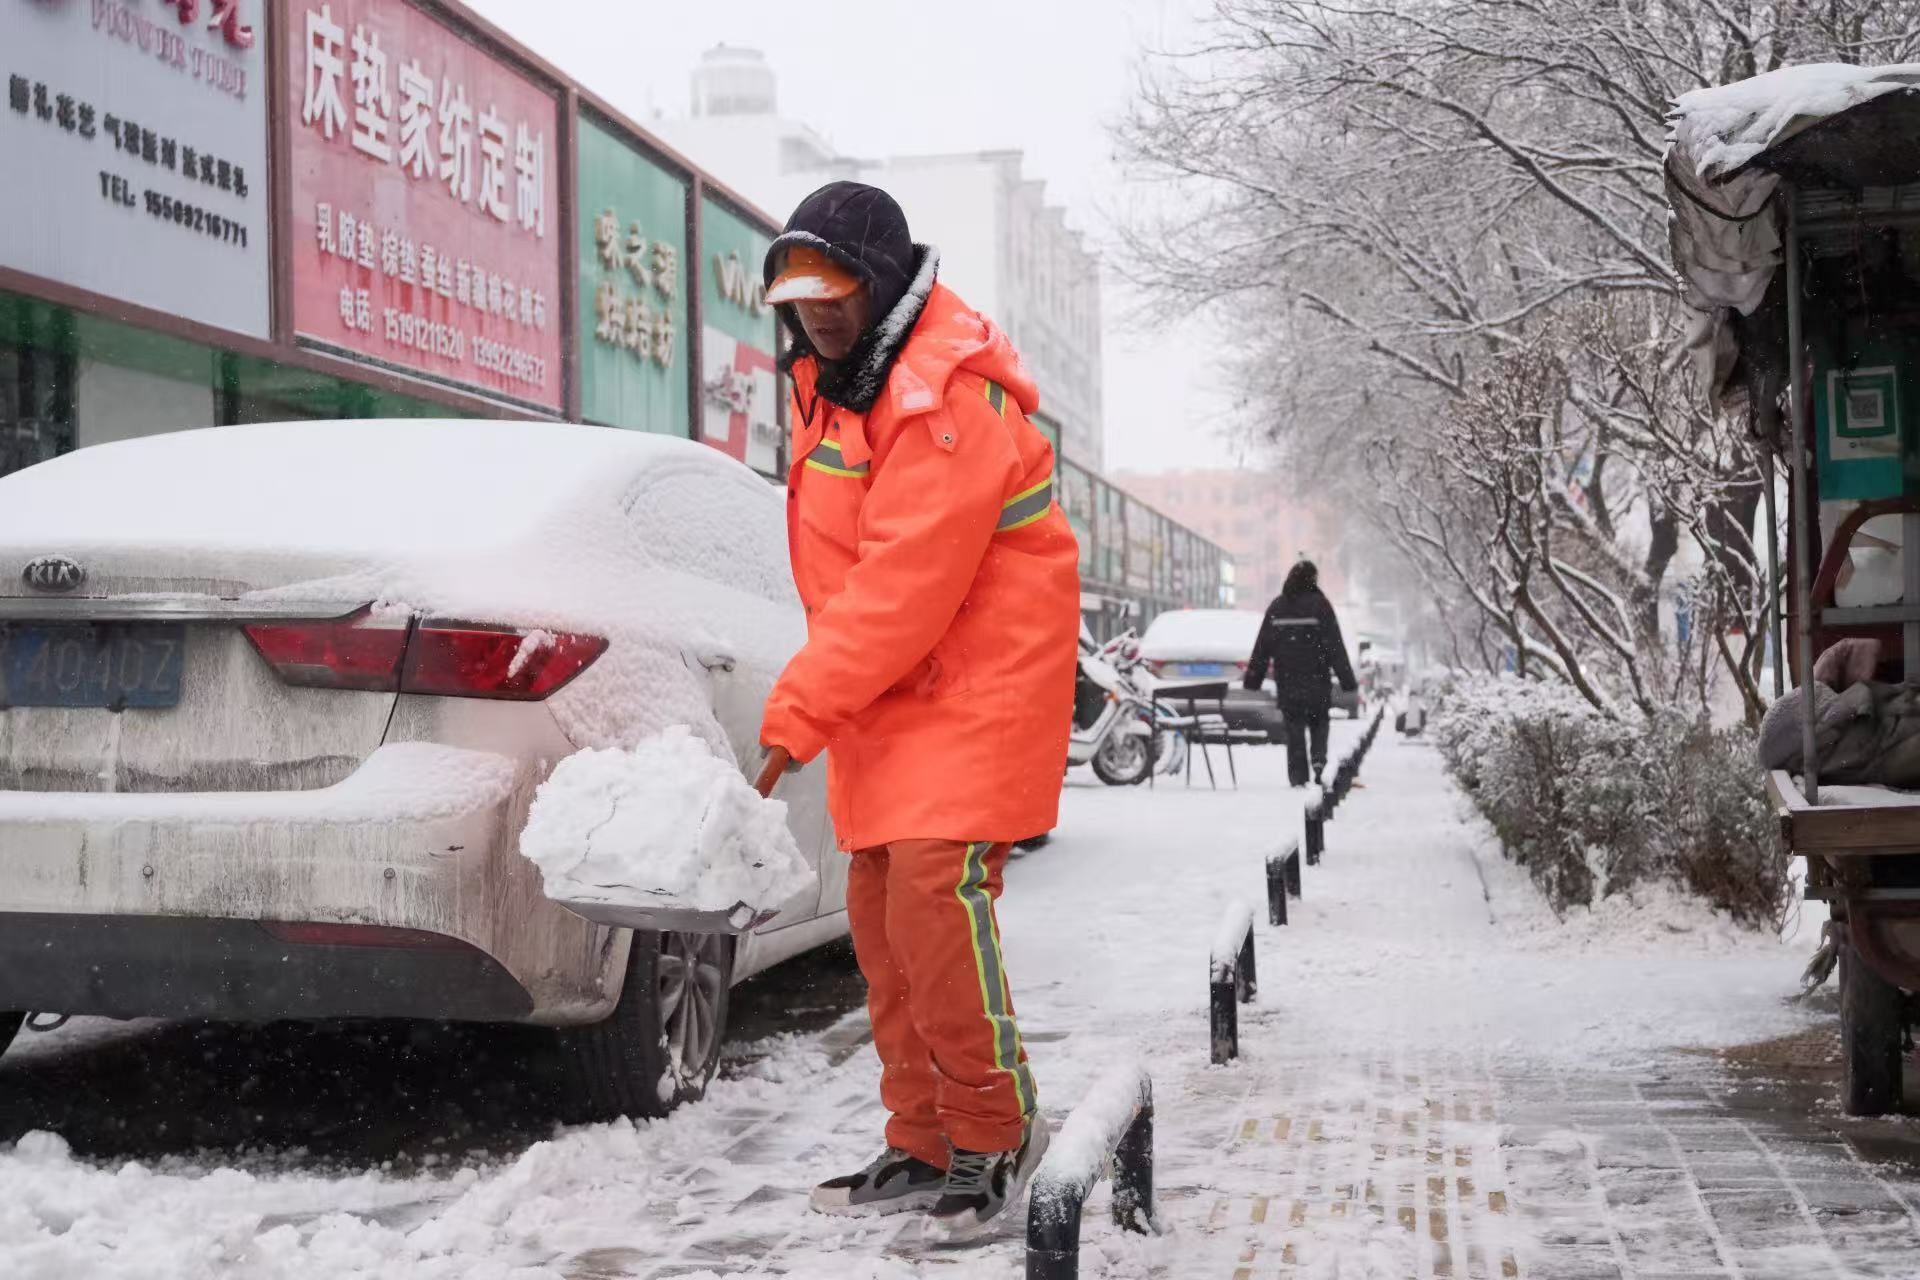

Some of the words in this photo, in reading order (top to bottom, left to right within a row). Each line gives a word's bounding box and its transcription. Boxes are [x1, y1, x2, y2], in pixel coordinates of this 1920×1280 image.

[302, 3, 546, 238] 床垫家纺定制
[315, 202, 376, 270] 乳胶垫
[381, 225, 416, 285] 棕垫
[31, 564, 74, 586] KIA
